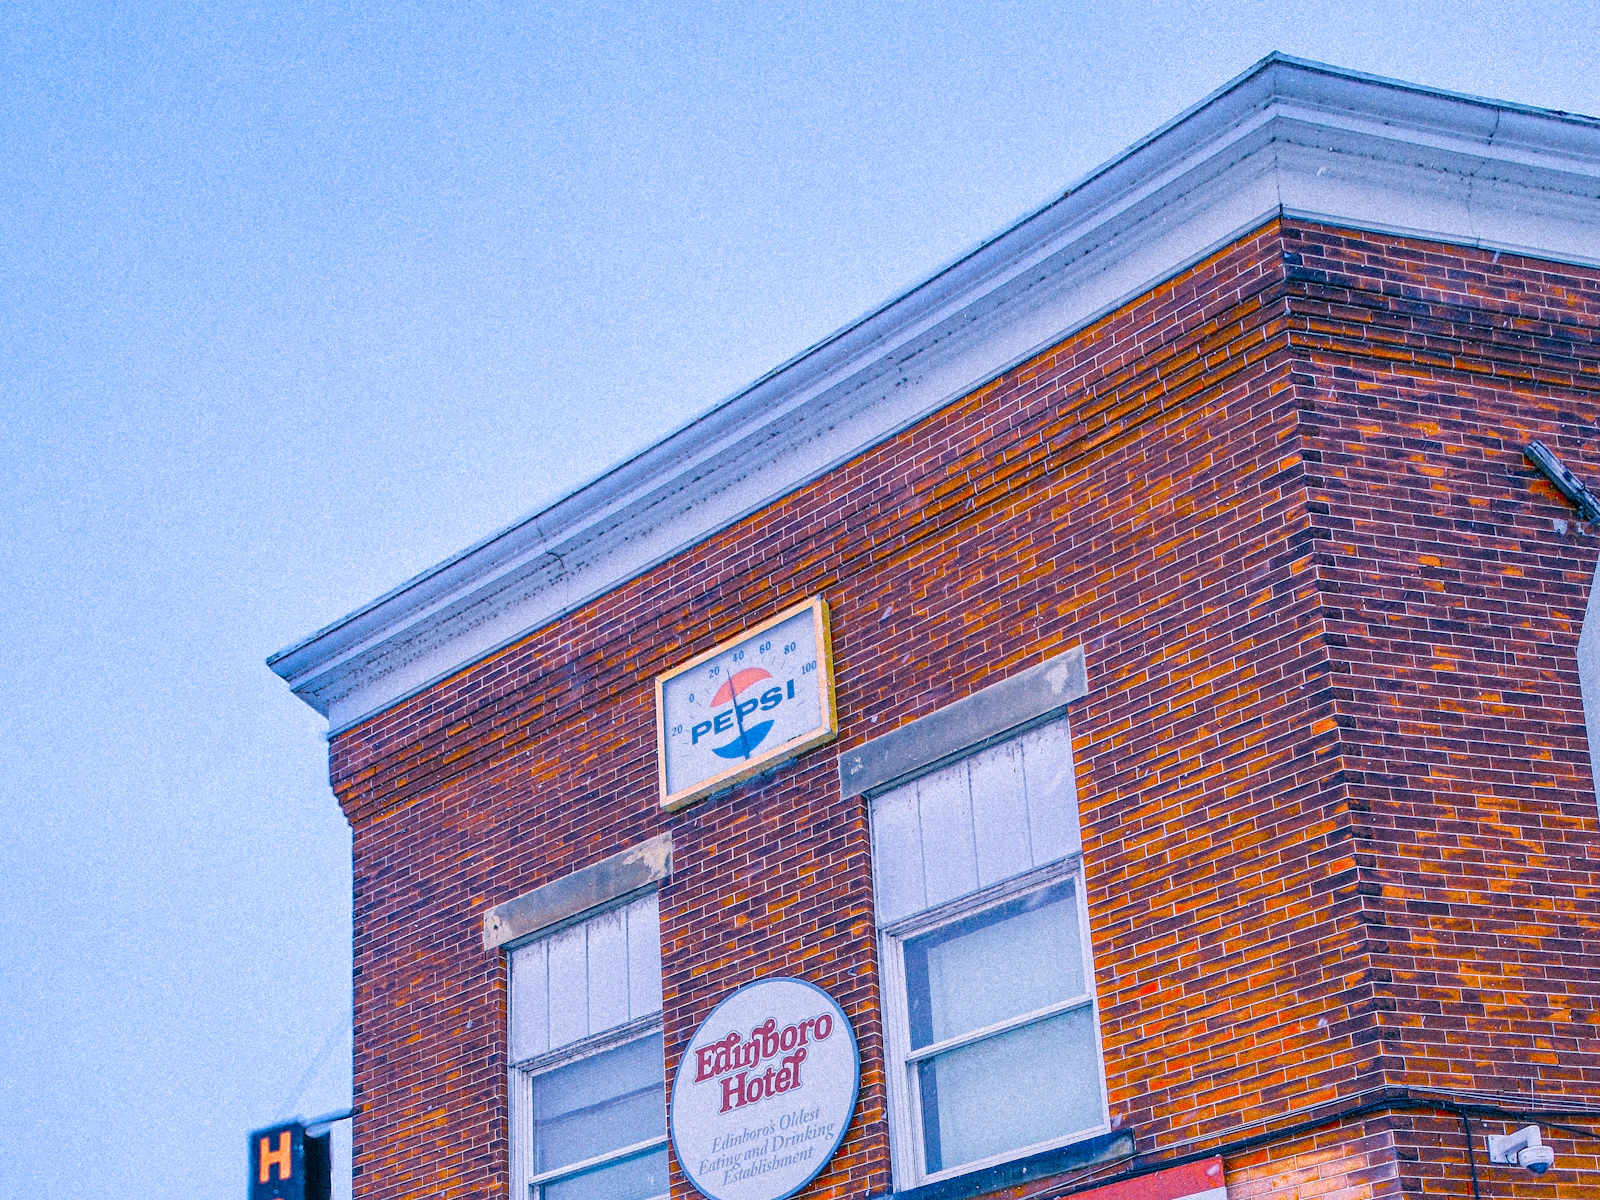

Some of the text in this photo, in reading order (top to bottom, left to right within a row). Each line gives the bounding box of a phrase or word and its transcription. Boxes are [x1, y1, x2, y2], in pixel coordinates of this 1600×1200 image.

[759, 641, 771, 653] 60
[784, 642, 796, 654] 80
[732, 650, 744, 663] 40
[708, 666, 720, 679] 20
[801, 660, 817, 675] 100
[689, 693, 695, 703] 0
[691, 679, 795, 746] PEPSI
[672, 724, 682, 737] 20
[694, 1014, 833, 1084] Edinboro
[719, 1047, 807, 1114] Hotel
[711, 1106, 821, 1154] Edinboro's Oldest
[697, 1123, 835, 1177] Eating and Drinking
[723, 1147, 814, 1186] Establishment
